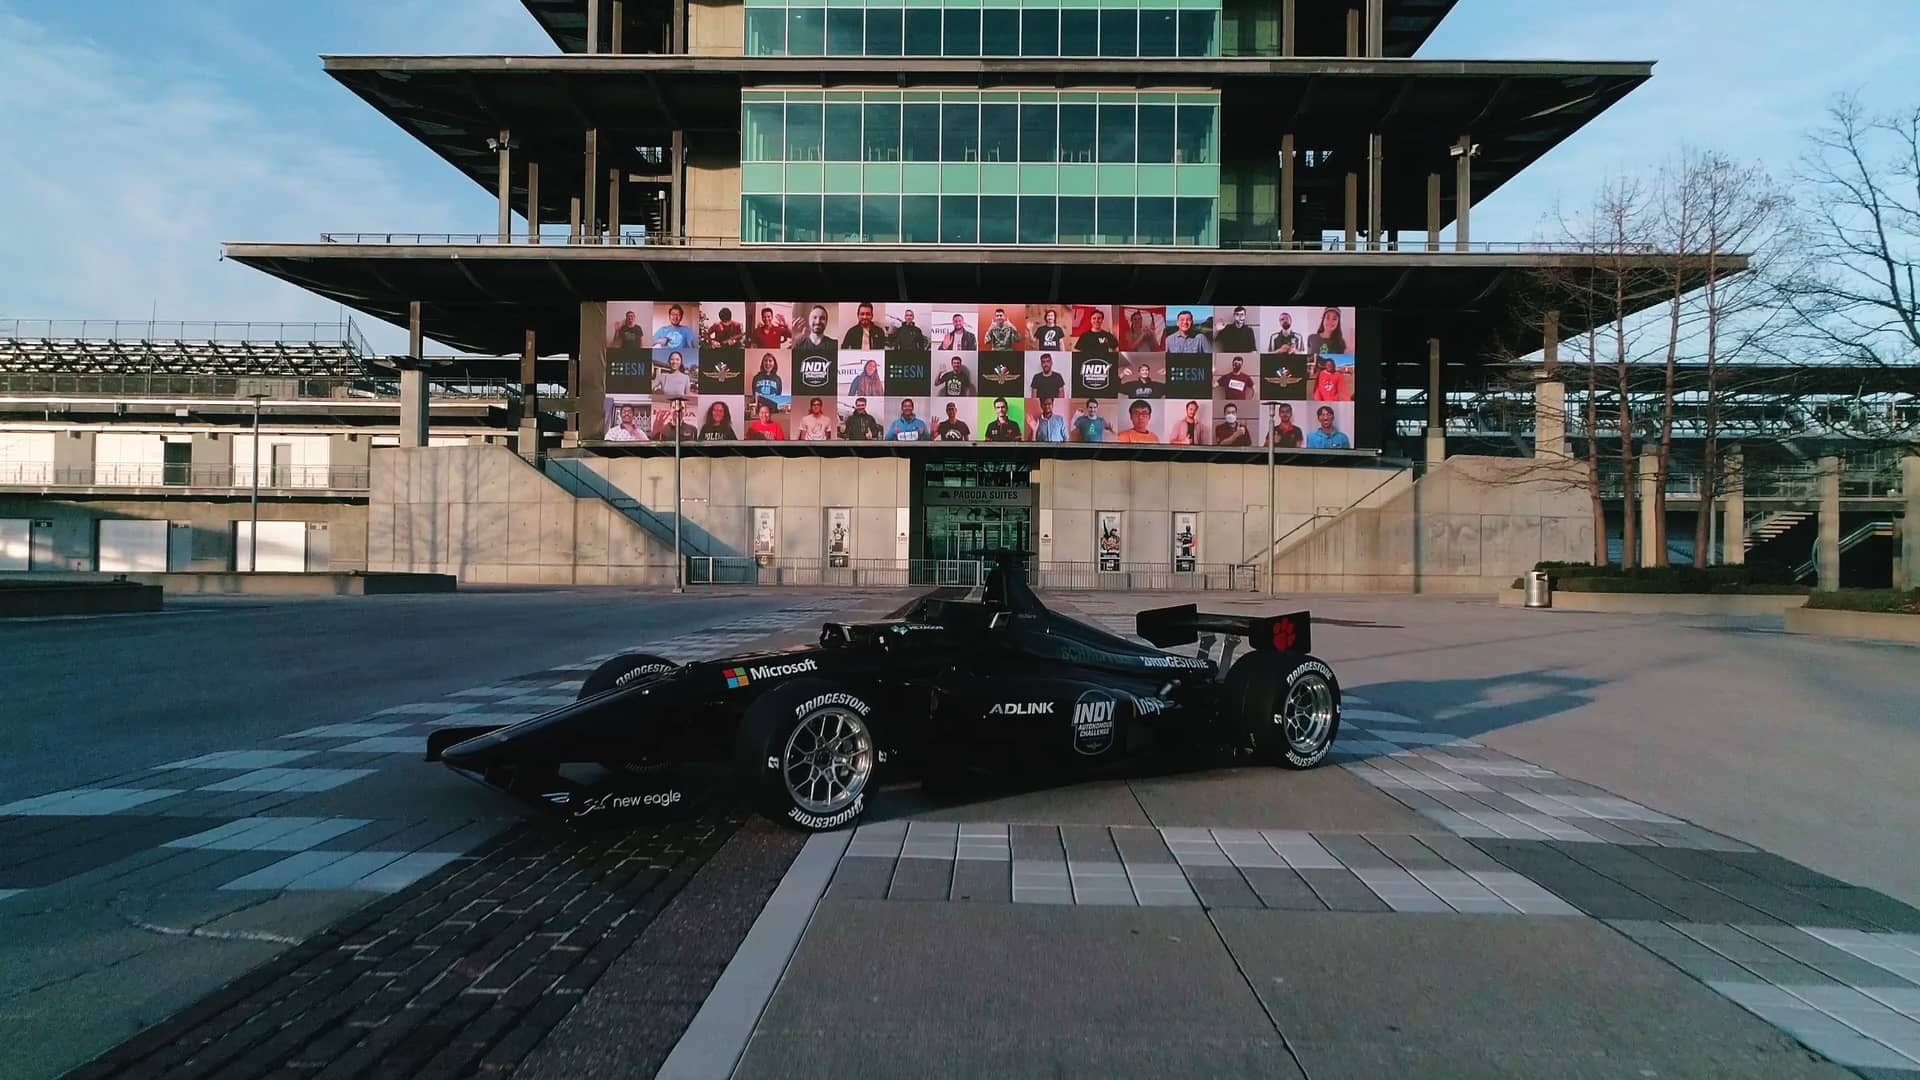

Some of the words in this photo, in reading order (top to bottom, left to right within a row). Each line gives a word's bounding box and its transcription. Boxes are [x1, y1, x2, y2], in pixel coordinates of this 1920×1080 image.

[624, 362, 646, 376] ESN
[801, 361, 832, 373] INDY
[903, 364, 925, 379] ESN
[1081, 364, 1112, 375] INDY
[1184, 367, 1206, 381] ESN
[953, 490, 987, 500] PAGODA
[989, 490, 1018, 500] SUITES
[1139, 655, 1209, 669] BRIDGESTONE
[615, 663, 672, 687] BRIDGESTO
[750, 658, 818, 681] Microsoft
[1286, 661, 1334, 687] BRIDGESTONE
[795, 692, 871, 720] BRIDGESTONE
[989, 702, 1055, 715] ADLINK
[1073, 700, 1116, 724] INDY
[1078, 721, 1113, 731] AUTONOMOUS
[1079, 728, 1110, 738] CHALLENGE
[613, 796, 642, 809] new
[643, 789, 682, 807] eagle
[788, 792, 865, 829] BRIDGESTONE
